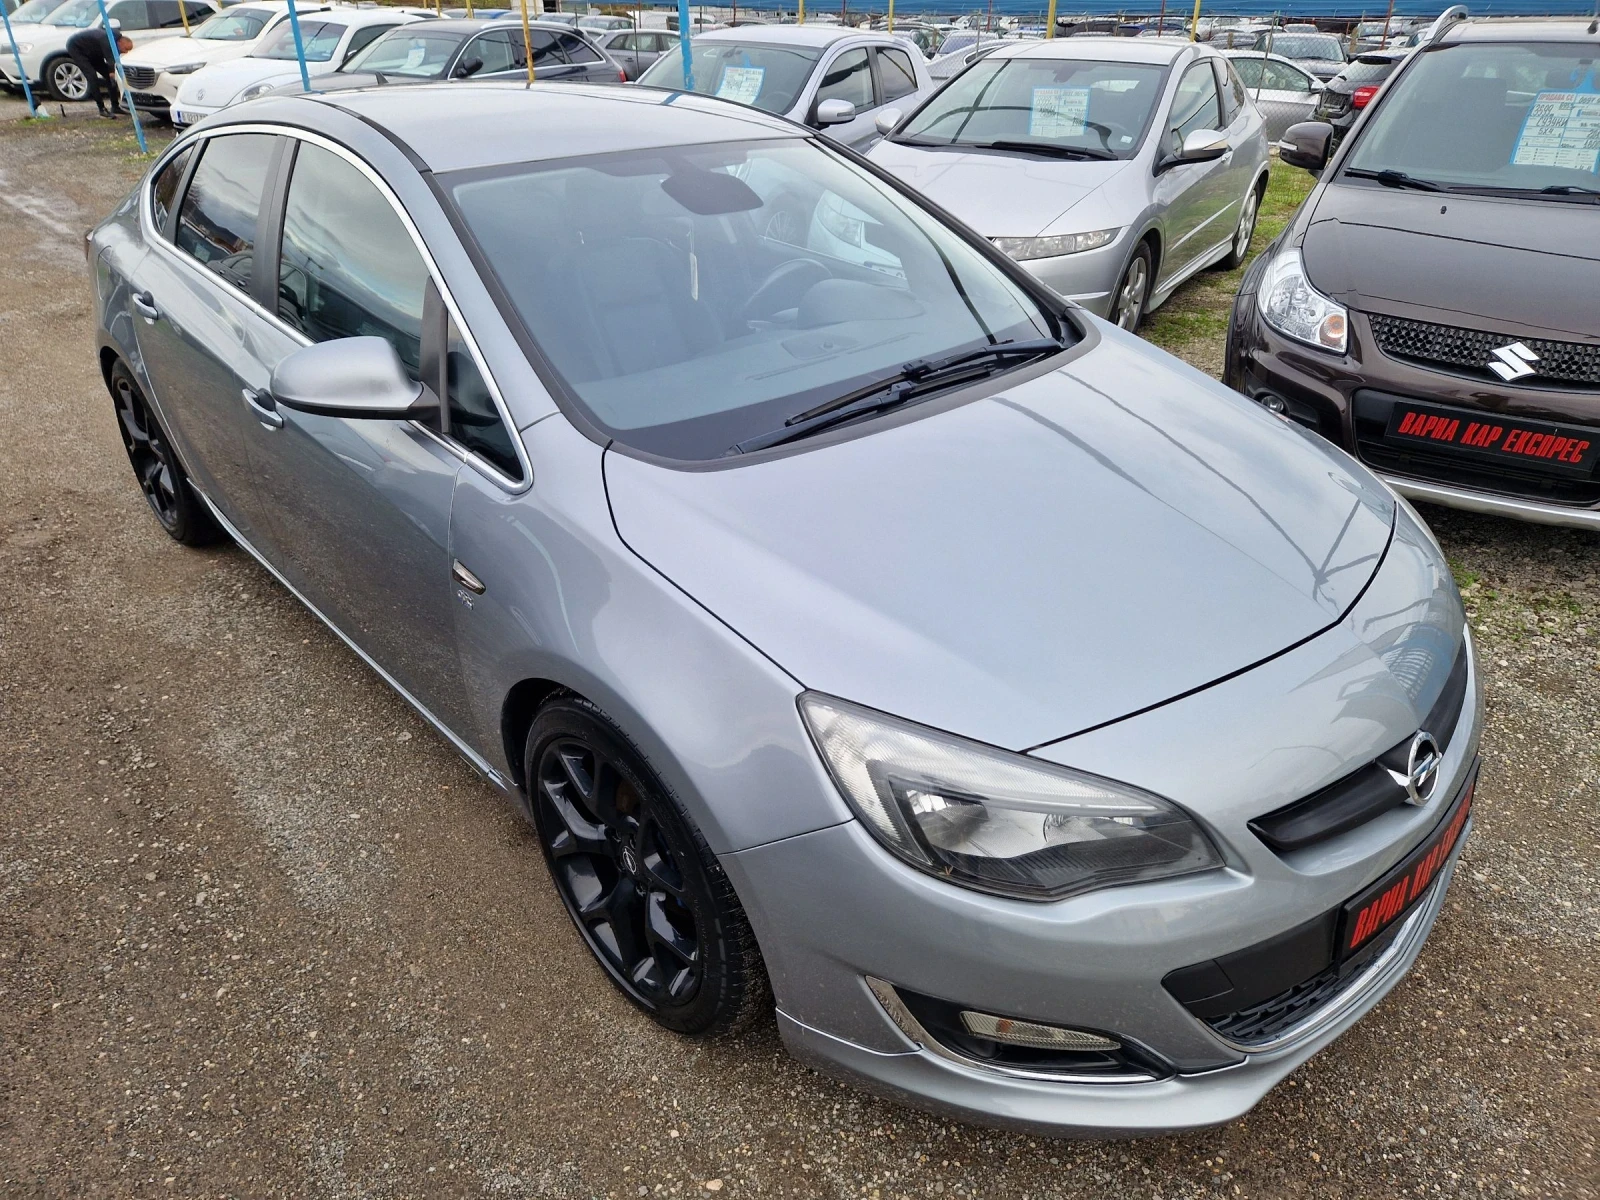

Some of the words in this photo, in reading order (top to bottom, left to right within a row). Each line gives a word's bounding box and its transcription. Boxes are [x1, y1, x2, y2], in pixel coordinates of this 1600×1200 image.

[1397, 411, 1460, 442] ВАРНА
[1460, 422, 1503, 448] КАР
[1501, 429, 1590, 463] ЕКСПРЕС
[1350, 875, 1409, 949] ВАРНА
